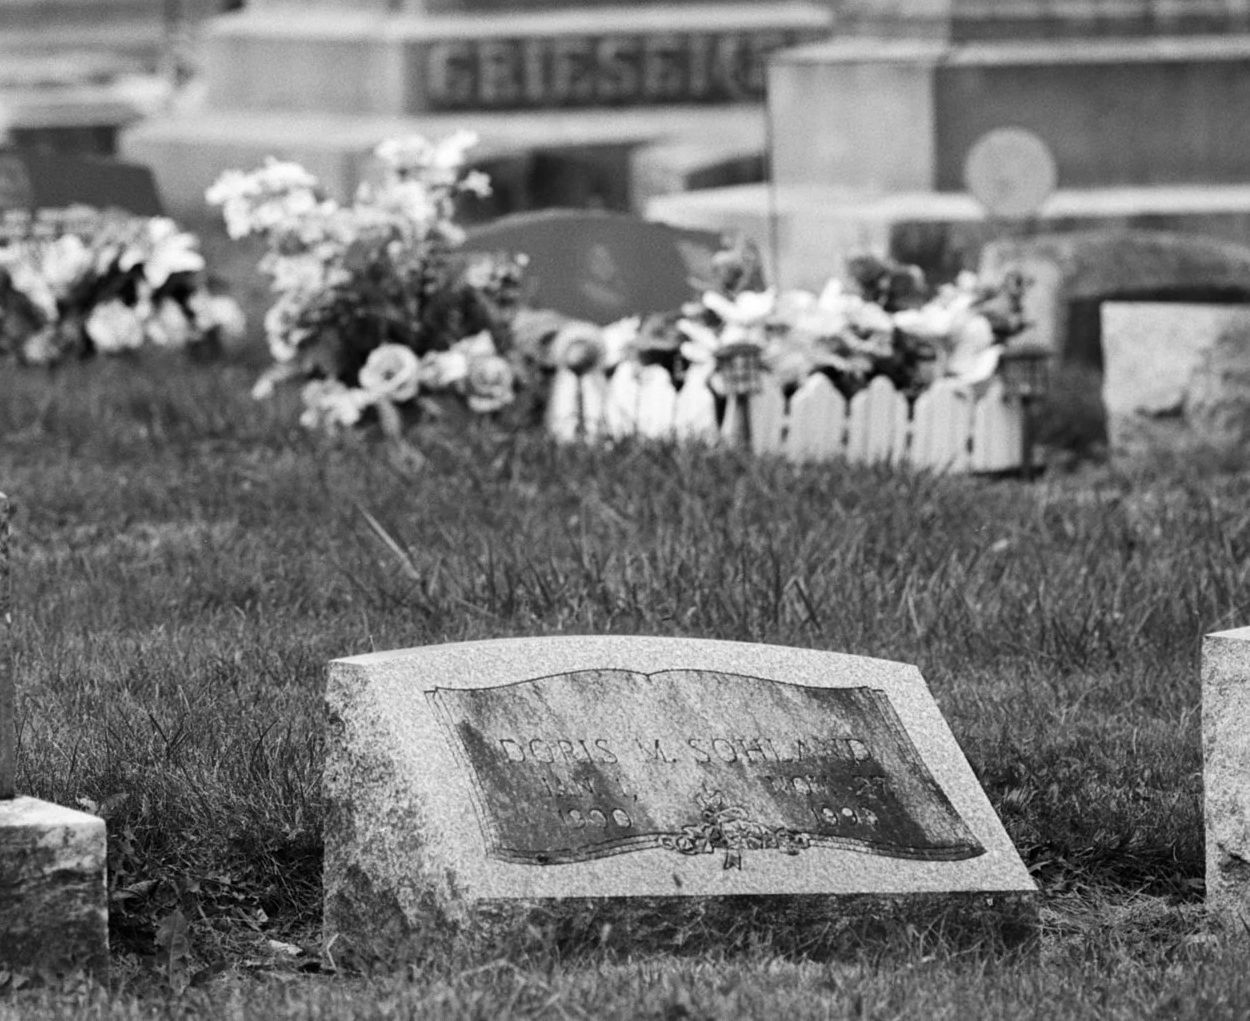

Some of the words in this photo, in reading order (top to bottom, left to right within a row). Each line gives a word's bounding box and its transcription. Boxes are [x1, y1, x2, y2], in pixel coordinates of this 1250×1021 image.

[499, 738, 619, 764] DORIS
[637, 738, 678, 764] M.
[688, 737, 874, 764] SOHLAND
